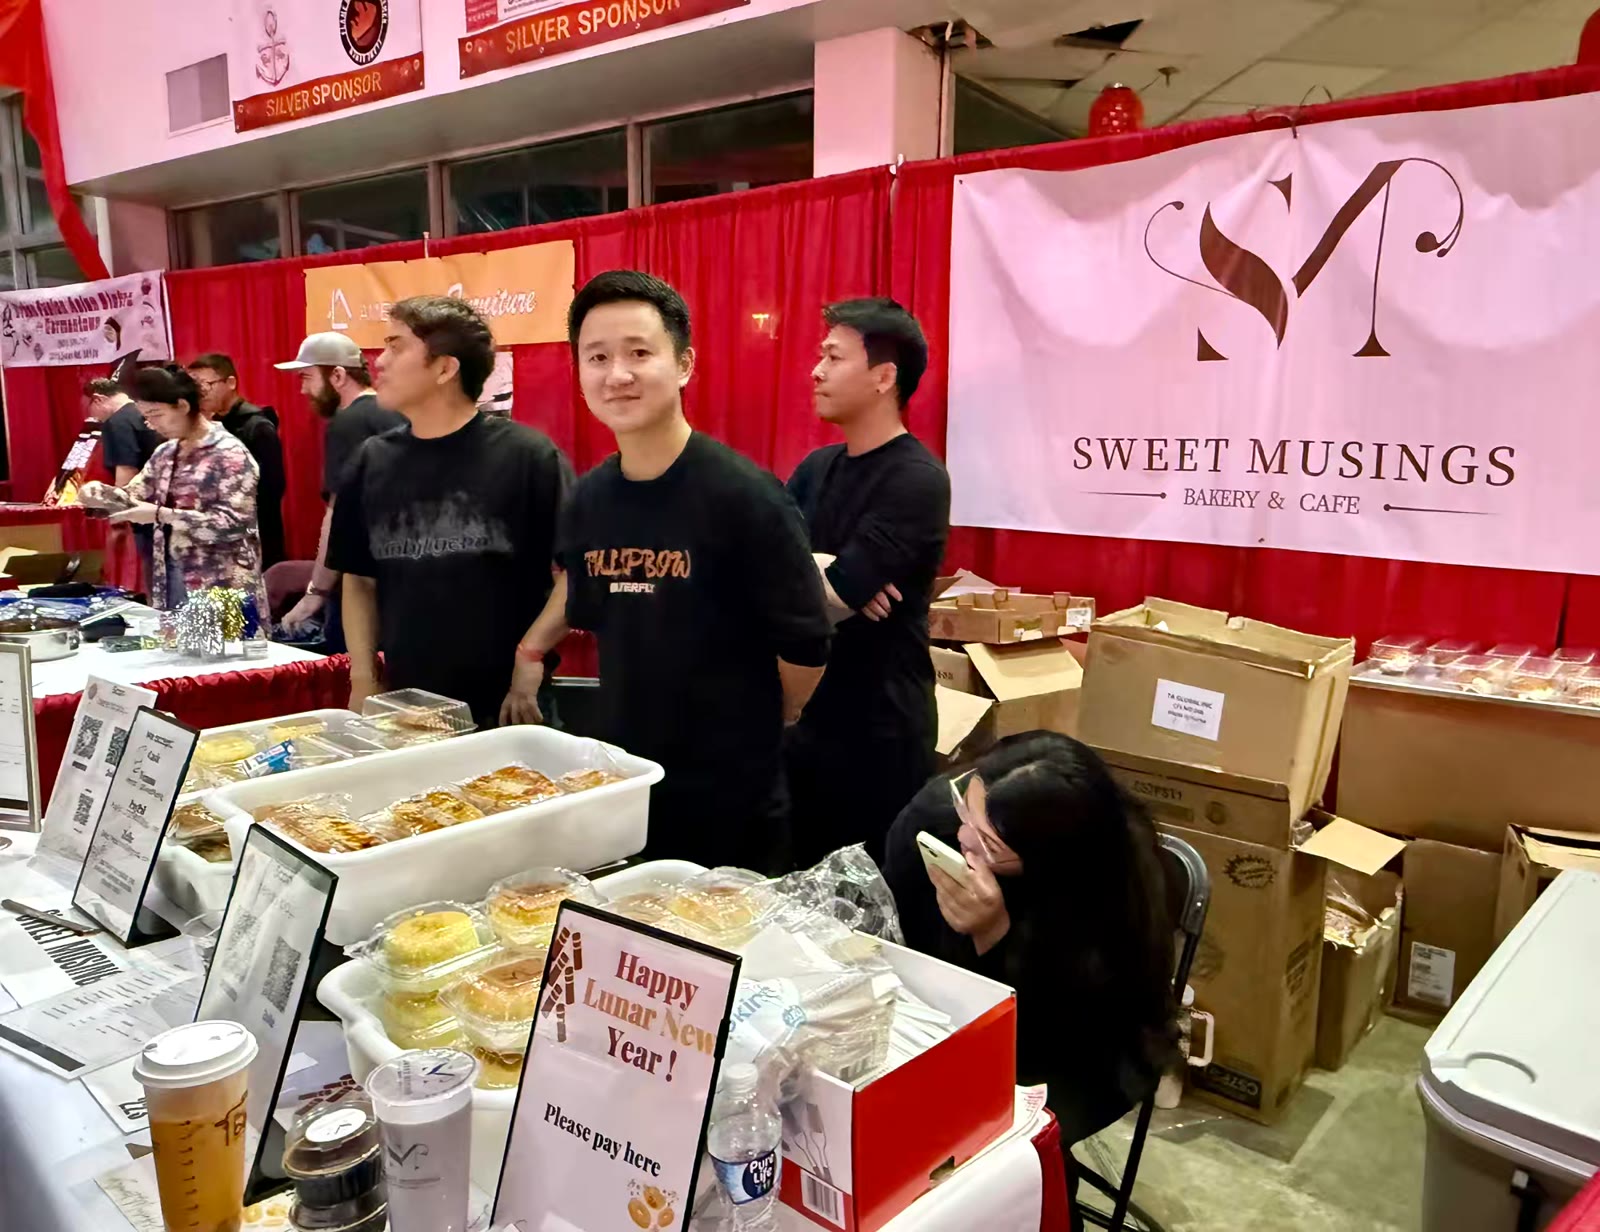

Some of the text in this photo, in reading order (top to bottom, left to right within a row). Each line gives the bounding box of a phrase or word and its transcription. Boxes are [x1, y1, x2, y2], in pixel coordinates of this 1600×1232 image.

[504, 15, 571, 54] SILVER
[265, 71, 382, 118] SILVER SPONSOR
[1073, 436, 1516, 487] SWEET MUSINGS
[1183, 487, 1361, 515] BAKERY & CAFE
[615, 950, 700, 1012] Happy
[582, 977, 716, 1056] Lunar New
[543, 1101, 662, 1178] Please pay here
